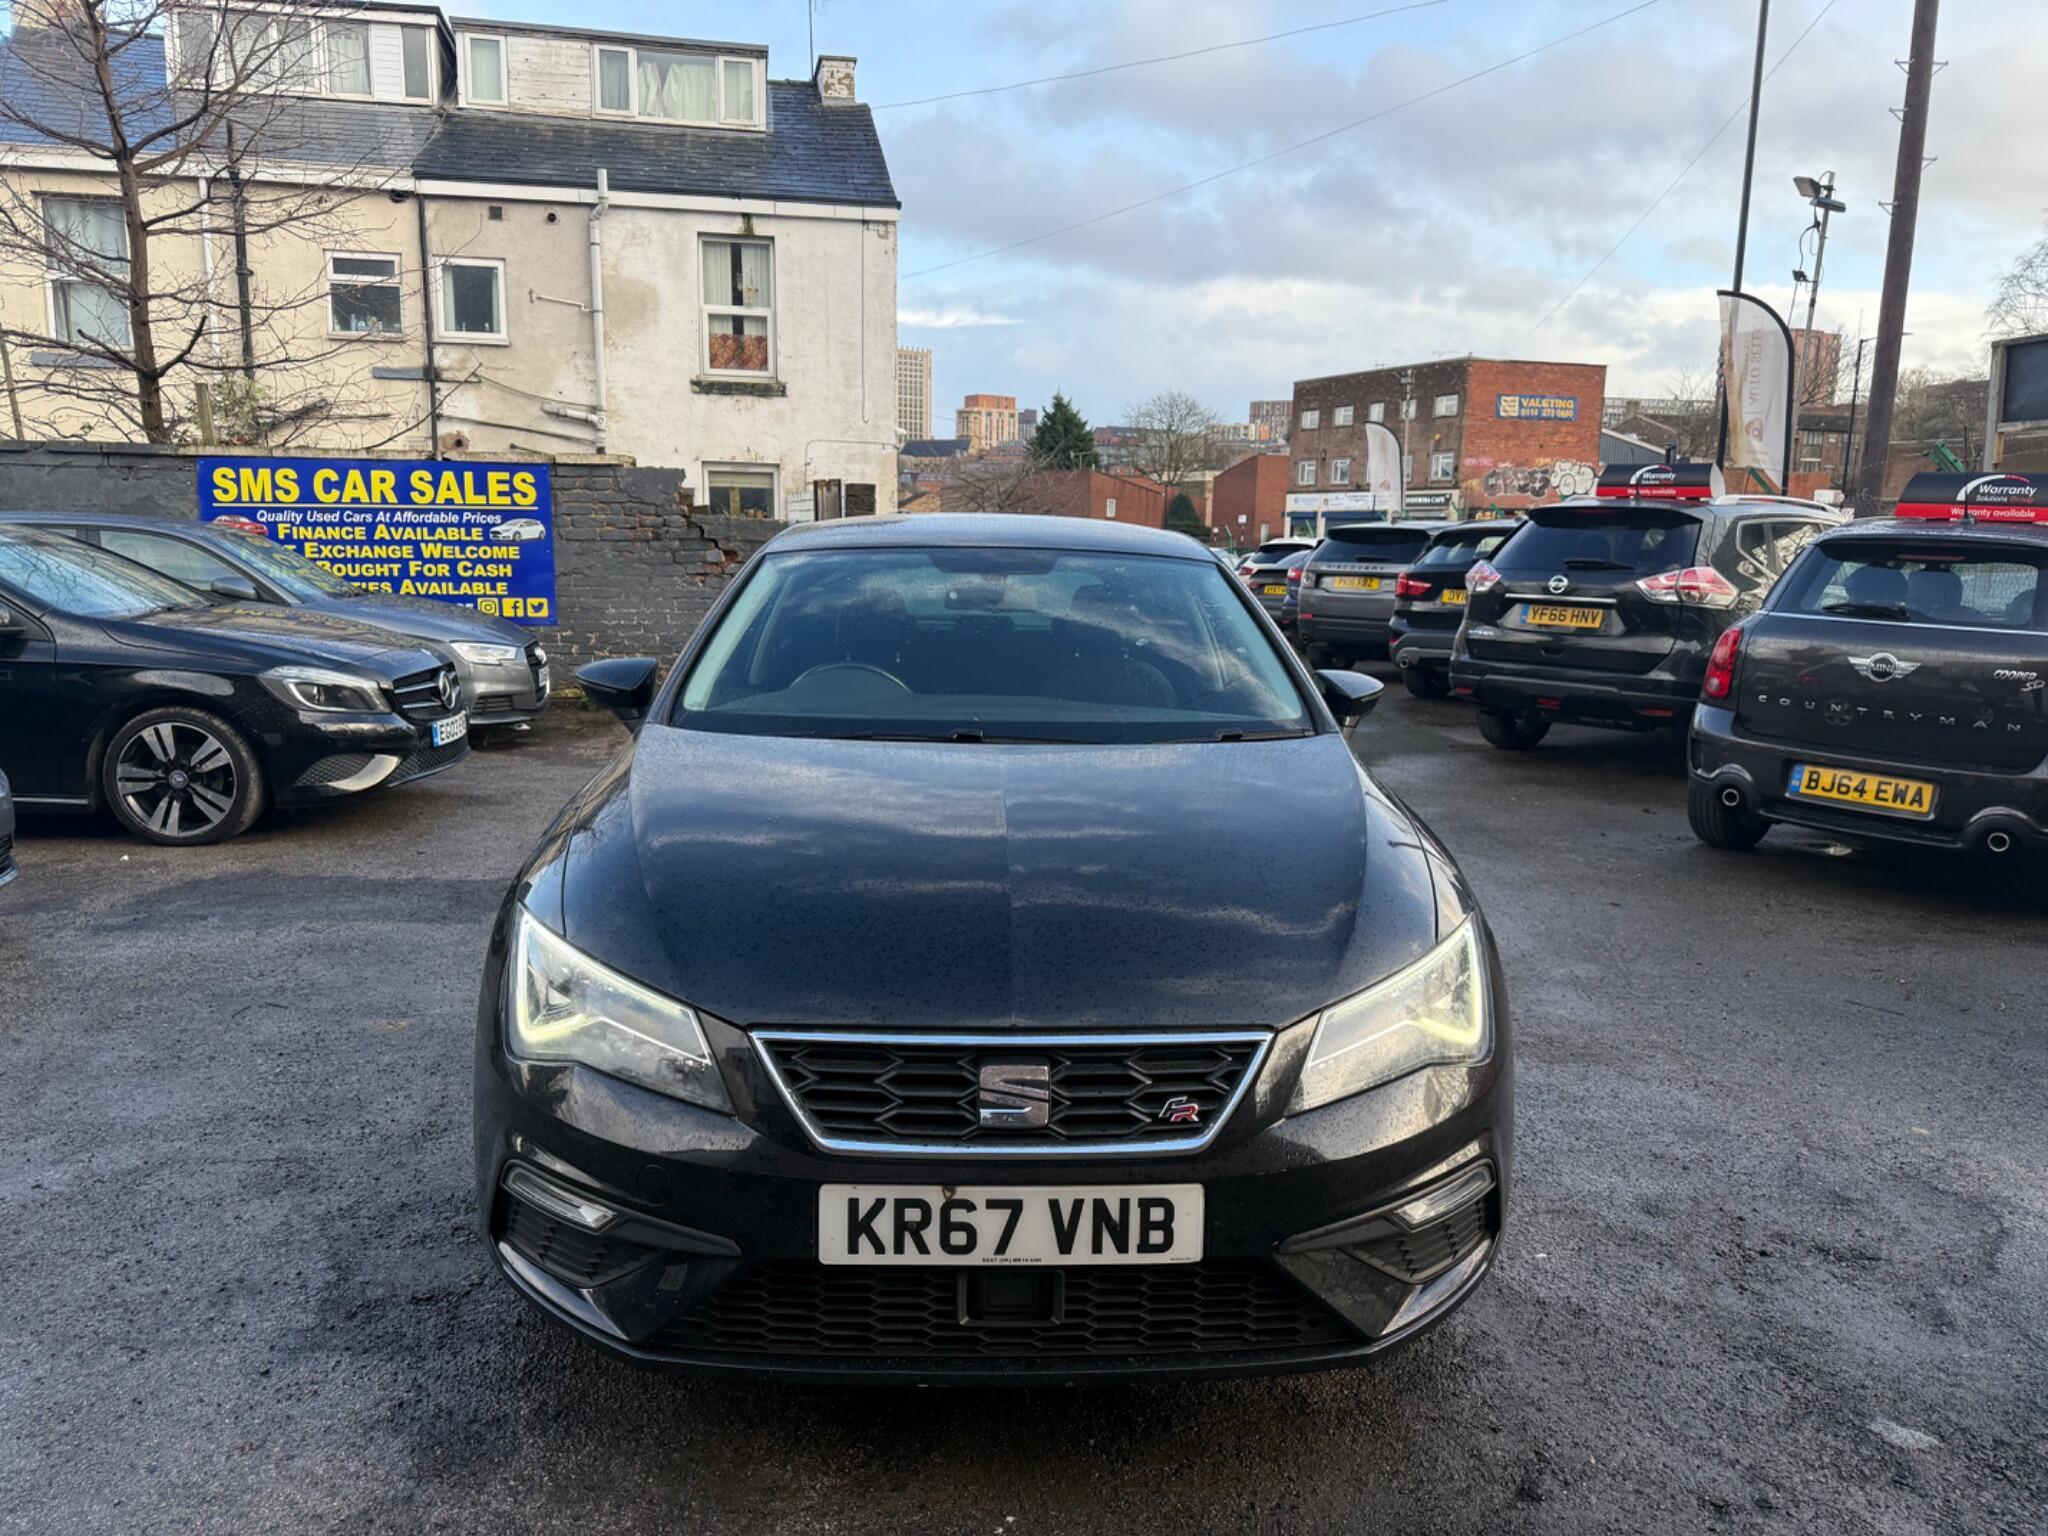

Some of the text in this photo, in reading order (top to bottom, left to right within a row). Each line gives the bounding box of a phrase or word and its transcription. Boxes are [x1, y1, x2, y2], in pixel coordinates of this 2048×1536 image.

[1521, 398, 1574, 409] VALETING
[212, 467, 537, 506] SMS CAR SALES
[1980, 484, 2038, 497] Warranty
[1976, 494, 2008, 502] Solutions
[257, 510, 502, 525] Quality Used Cars At Affordable Prices
[1993, 509, 2036, 518] available
[278, 523, 484, 541] FINANCE AVAILABLE
[304, 542, 414, 559] EXCHANGE
[420, 543, 520, 559] WELCOME
[409, 561, 451, 577] FOR
[457, 561, 512, 577] CASH
[399, 579, 508, 595] AVAILABLE
[1532, 607, 1600, 624] YF66 HNV
[1993, 669, 2037, 680] COOPER
[2020, 680, 2046, 691] SD
[1758, 694, 2021, 733] COUNTRYMAN
[1805, 770, 1924, 808] BJ64 EWA
[1158, 1096, 1199, 1122] FR
[847, 1197, 1175, 1256] KR67 VNB
